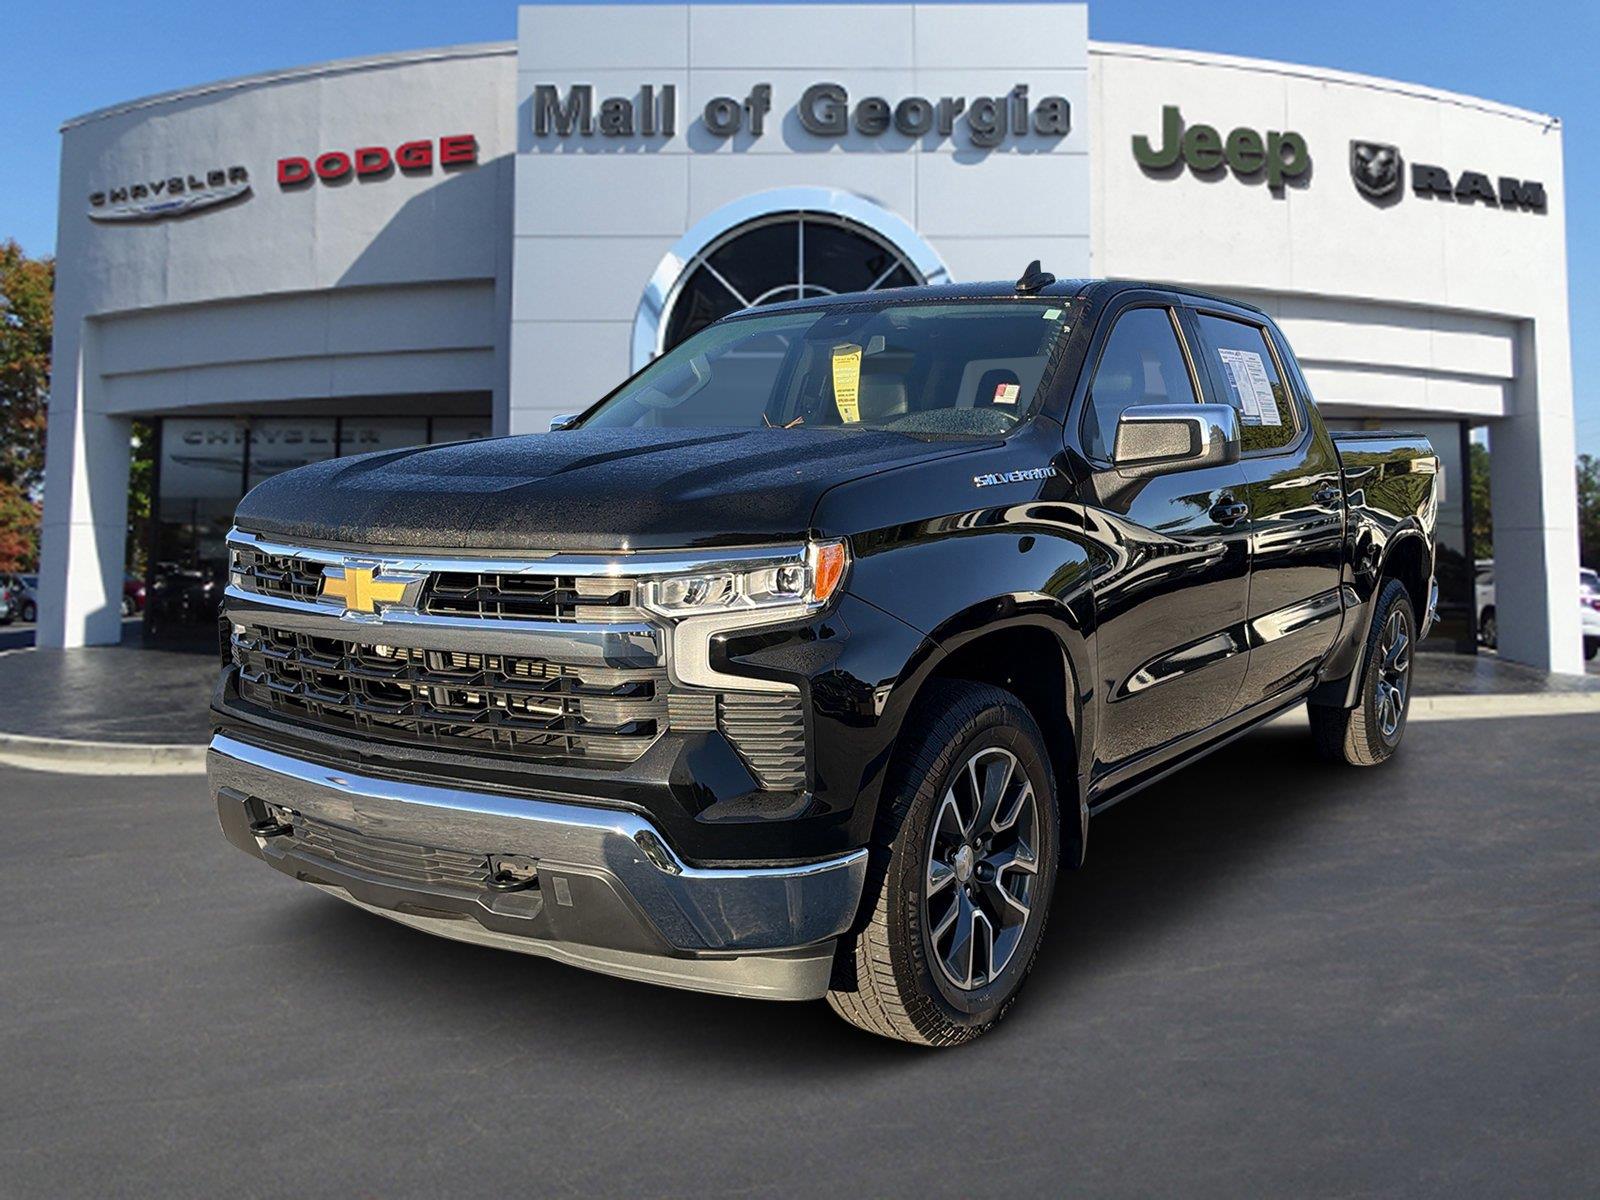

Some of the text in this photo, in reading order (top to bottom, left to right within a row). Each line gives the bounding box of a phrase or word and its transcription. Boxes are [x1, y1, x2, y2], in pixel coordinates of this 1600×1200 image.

[532, 82, 1073, 149] Mall of Georgia
[277, 134, 477, 187] DODGE
[1132, 105, 1309, 190] Jeep
[89, 166, 249, 207] CHRYSLER
[1411, 163, 1547, 212] RAM
[973, 465, 1057, 488] SILVERADO
